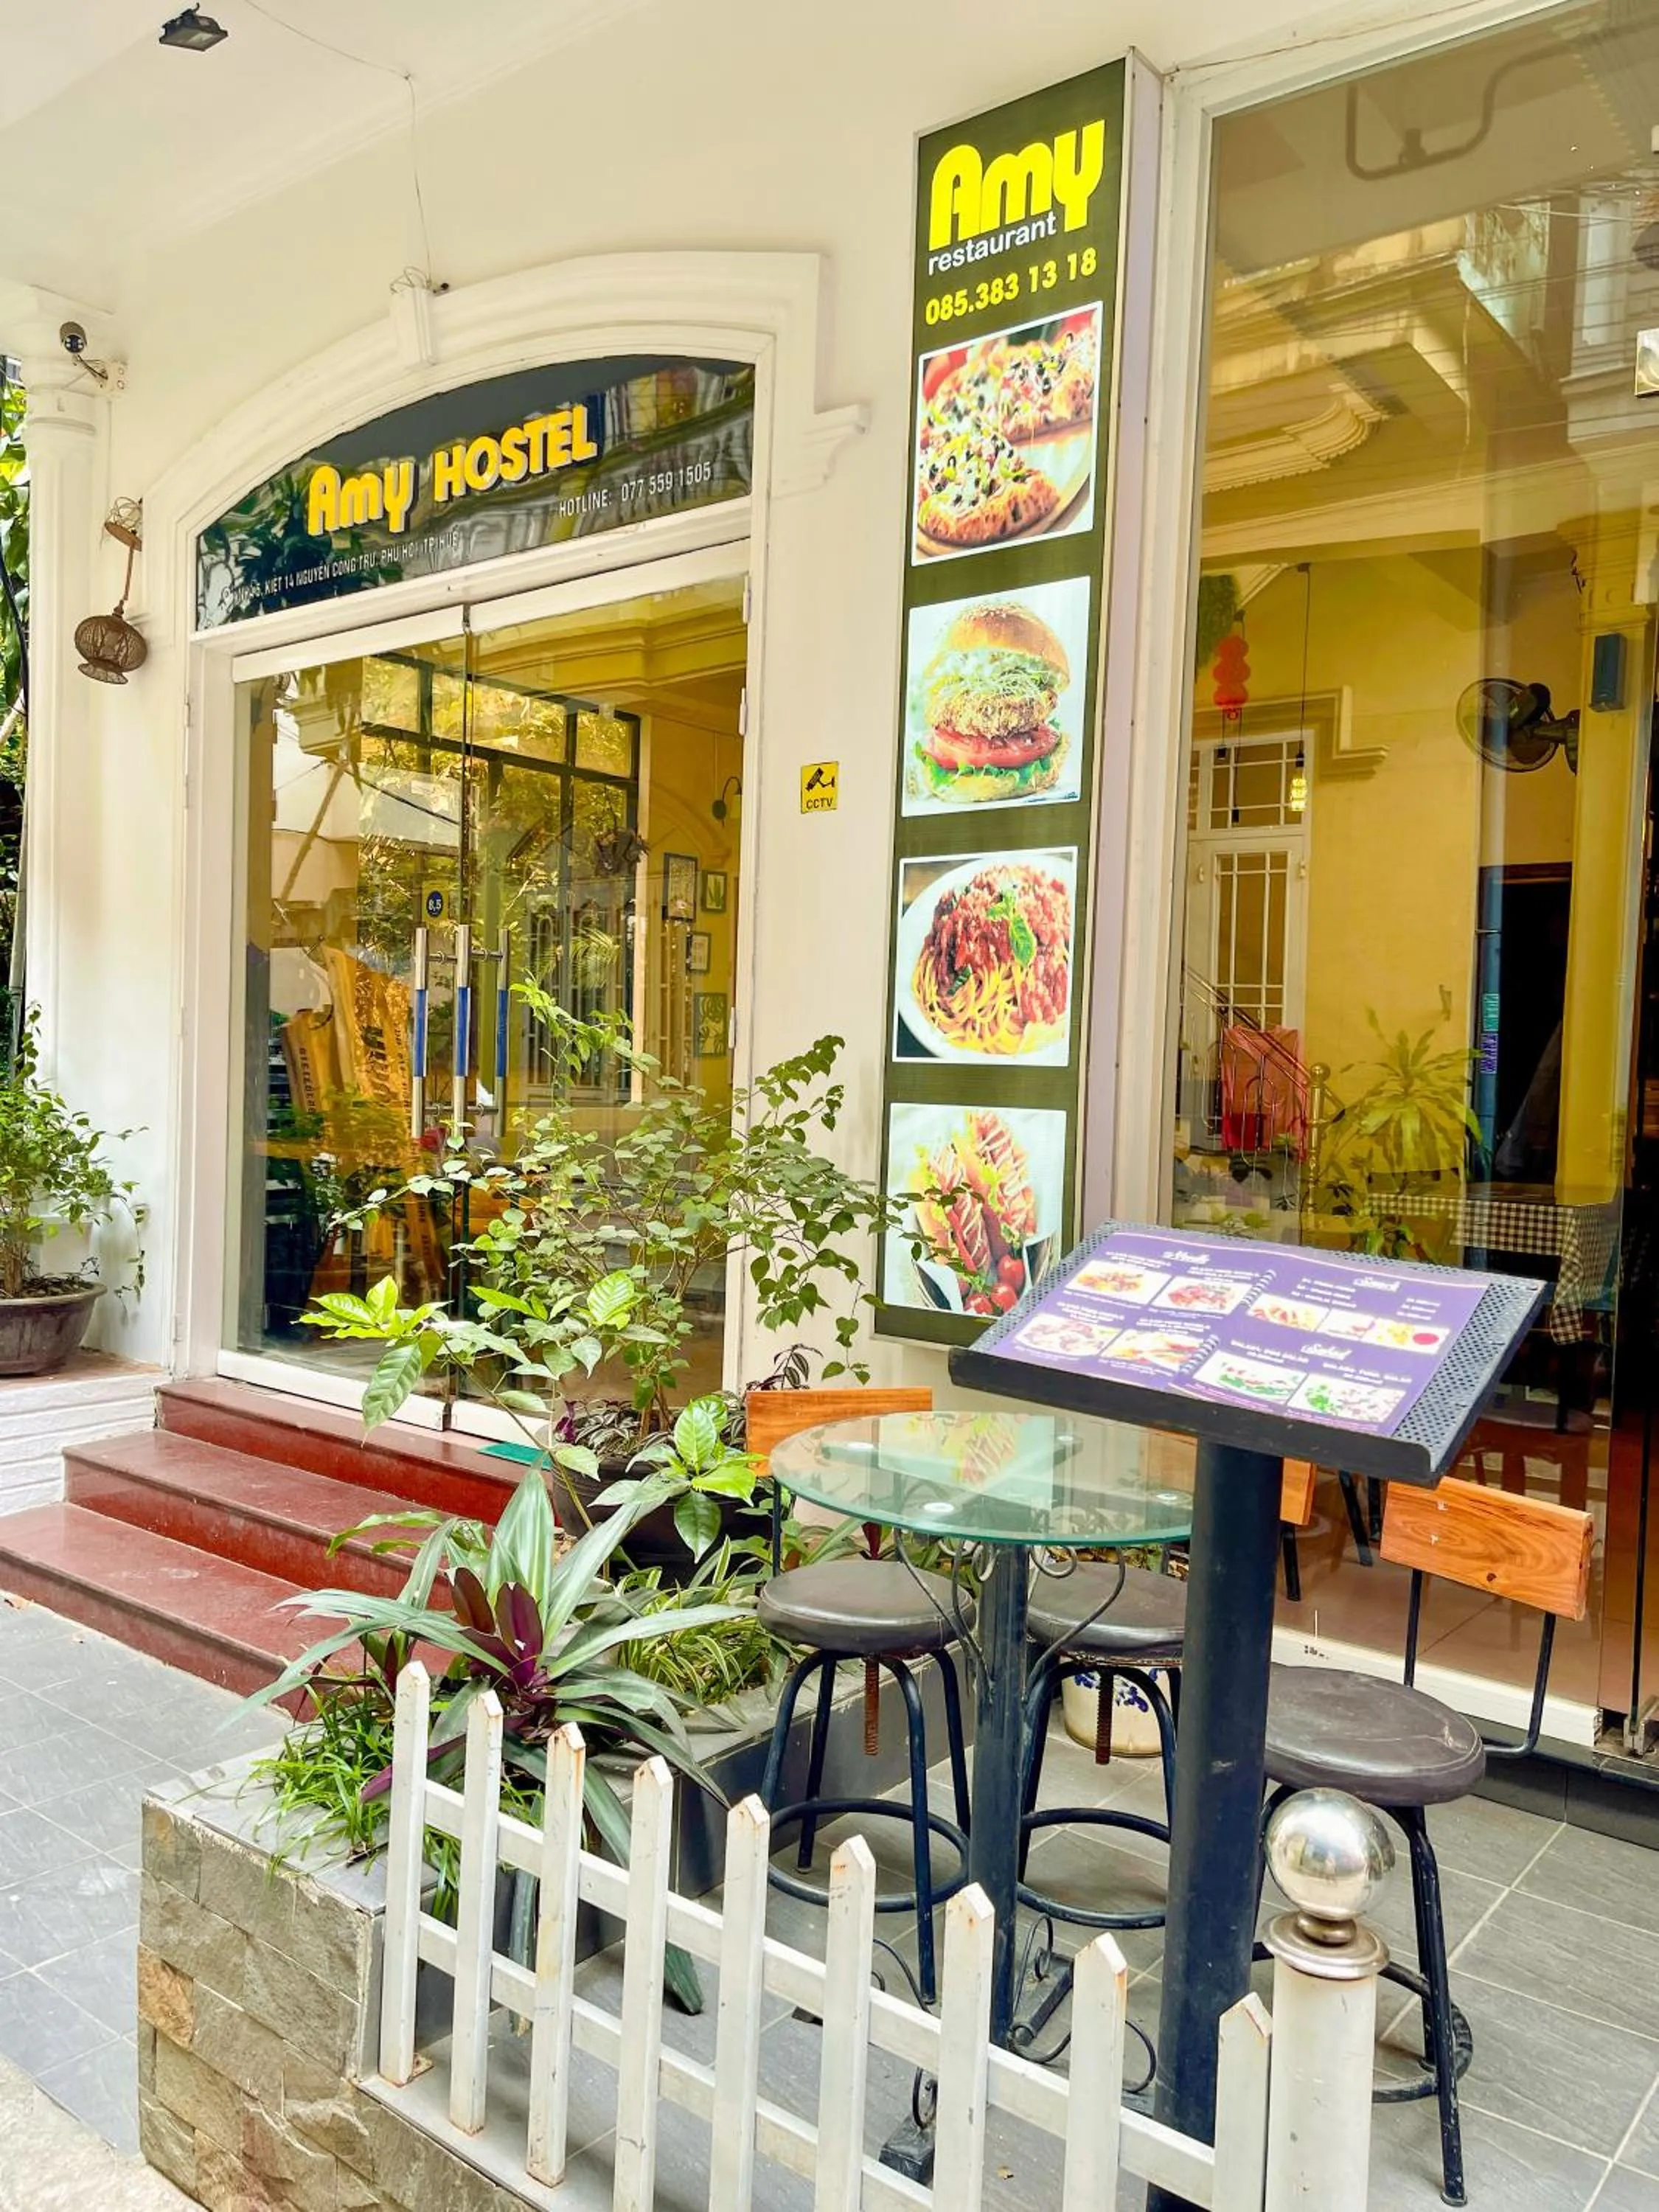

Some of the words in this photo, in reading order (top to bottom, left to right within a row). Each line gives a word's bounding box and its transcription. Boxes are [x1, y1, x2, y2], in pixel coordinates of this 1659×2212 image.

[928, 119, 1105, 251] Amy
[928, 211, 1057, 276] restaurant
[925, 272, 1019, 325] 085.383
[1029, 260, 1057, 293] 13
[1068, 248, 1096, 281] 18
[307, 461, 416, 537] Amy
[434, 404, 597, 502] HOSTEL
[560, 489, 612, 518] HOTLINE:
[622, 479, 644, 502] 077
[649, 471, 673, 495] 559
[679, 461, 711, 487] 1505
[806, 796, 833, 810] CCTV
